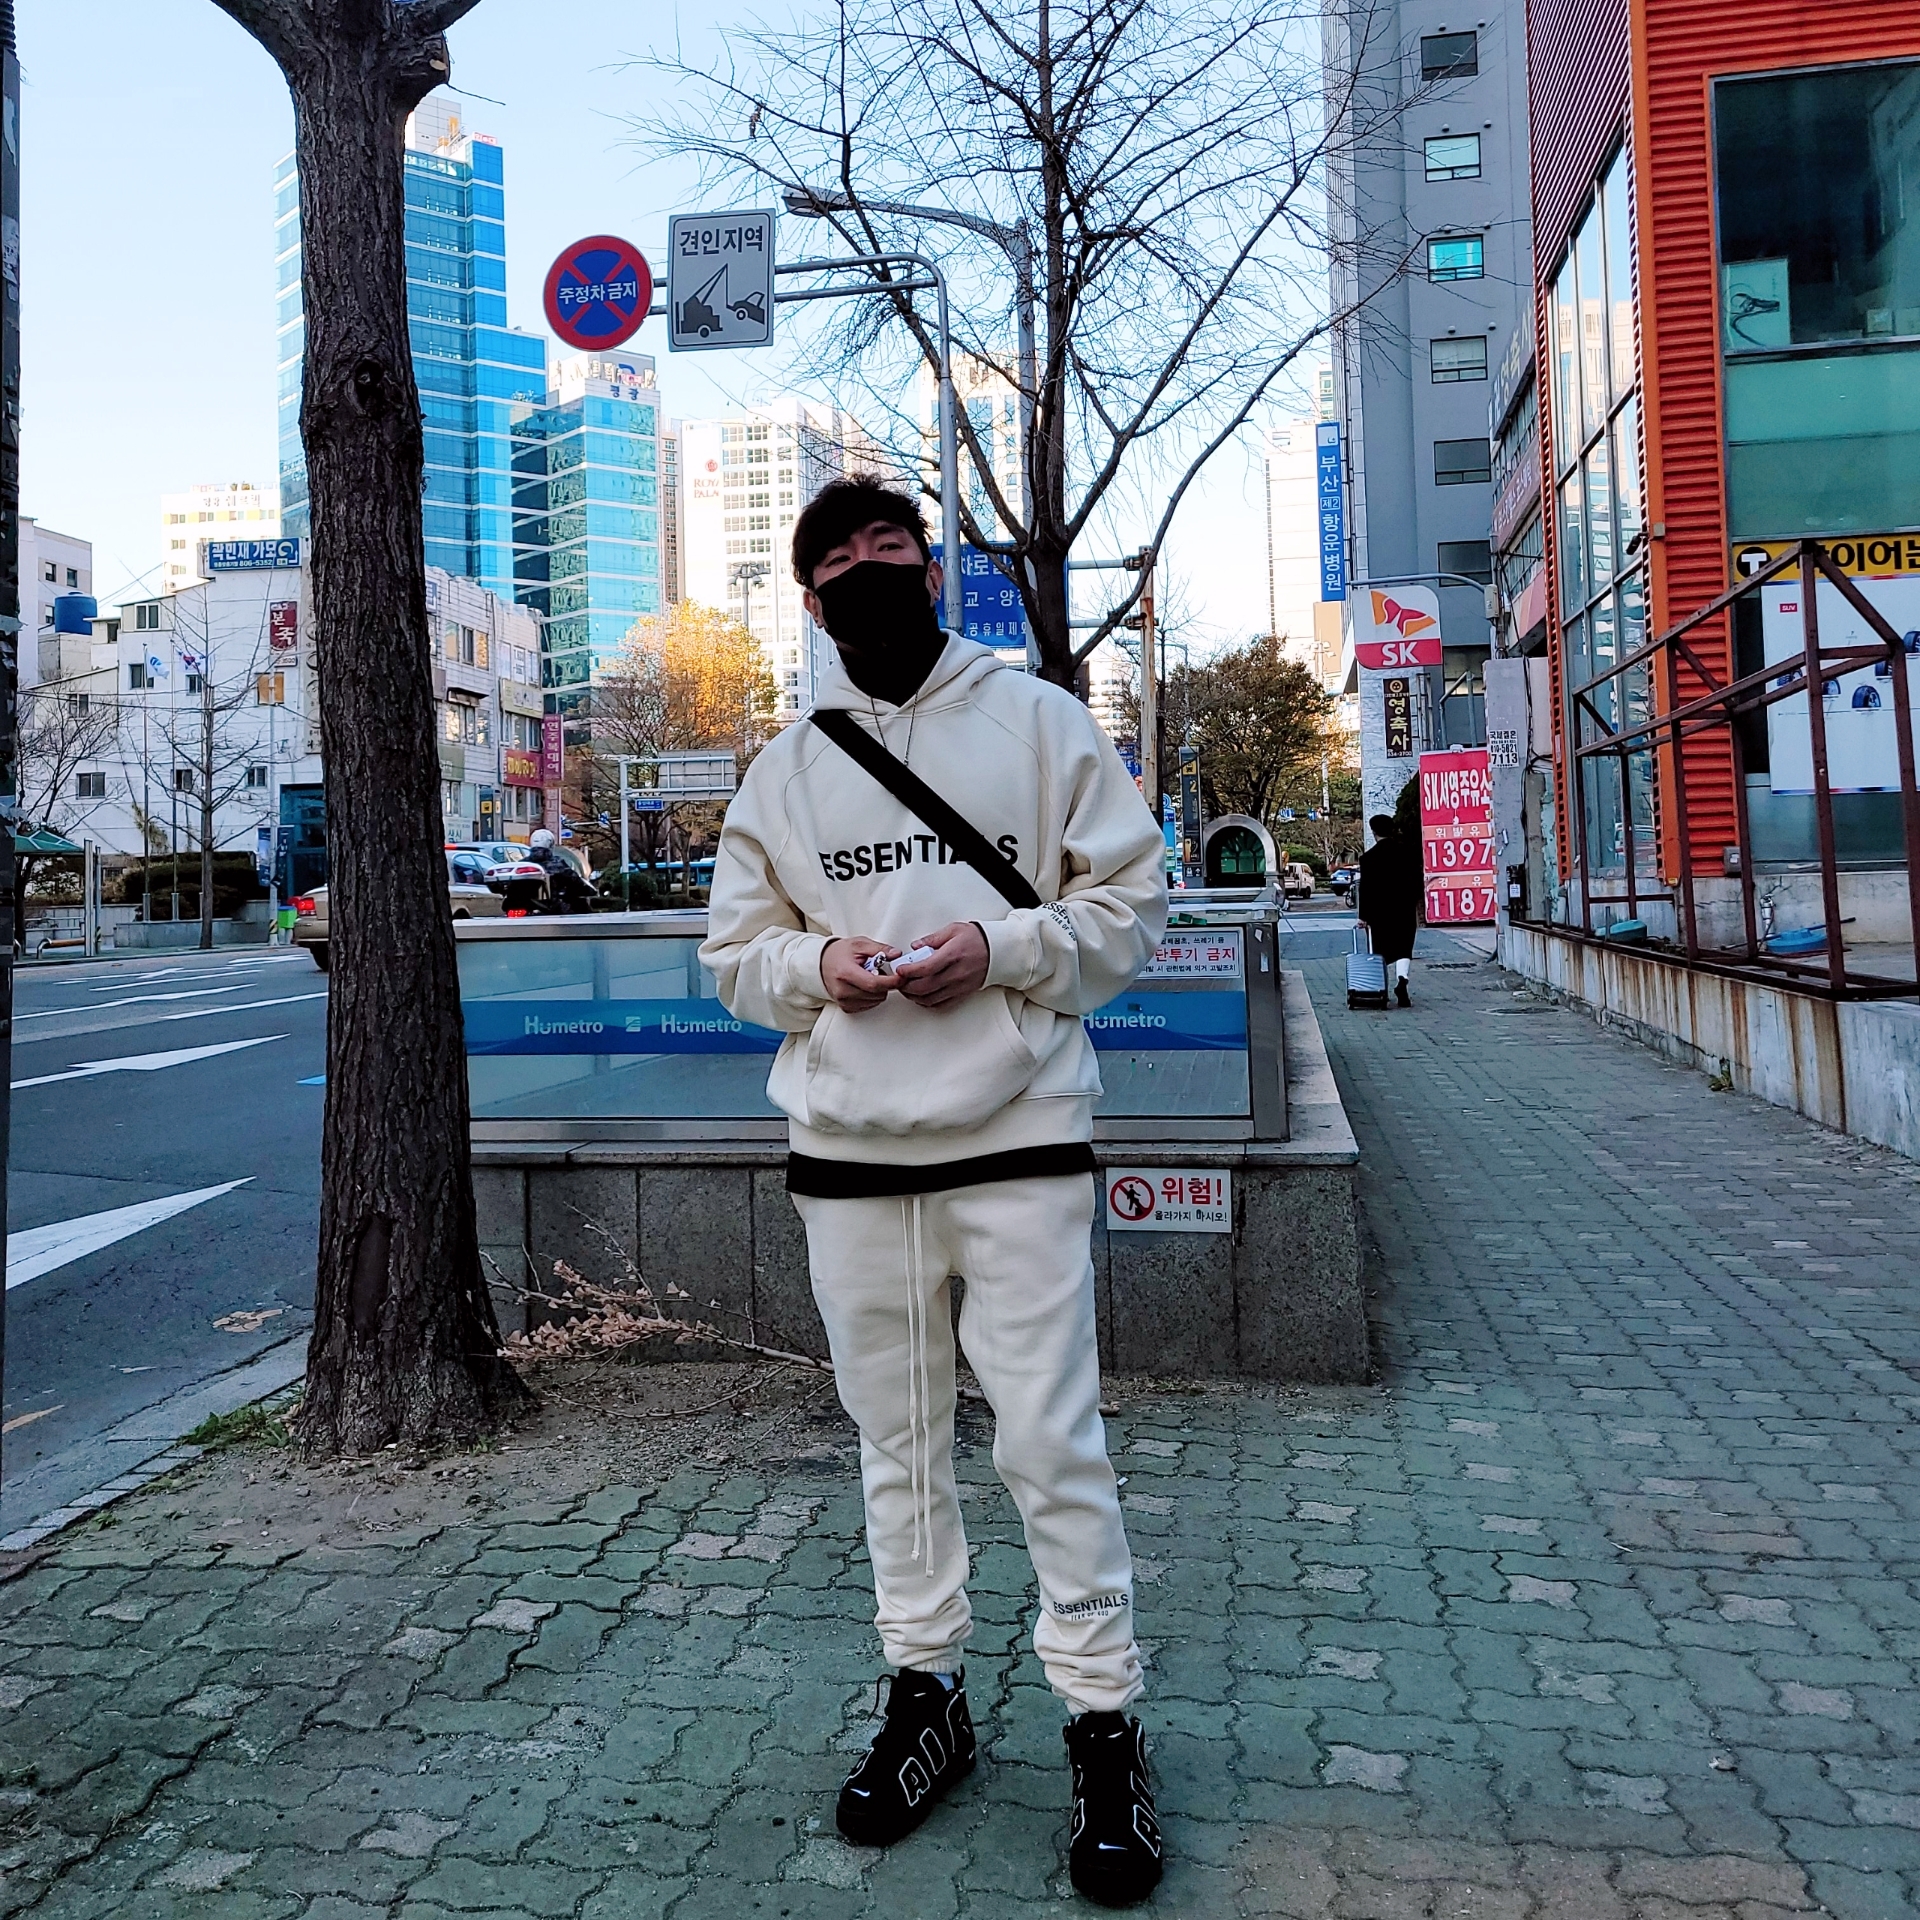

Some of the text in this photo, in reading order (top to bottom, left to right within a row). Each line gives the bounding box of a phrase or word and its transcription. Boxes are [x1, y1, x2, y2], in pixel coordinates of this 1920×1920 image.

[680, 226, 763, 256] 견인지역
[559, 281, 637, 304] 주정차 금지
[1320, 455, 1342, 592] 부산 제2 항운병원
[271, 611, 296, 646] 본죽
[1382, 641, 1420, 666] SK
[1388, 698, 1411, 751] 영축사
[1491, 753, 1518, 765] 7113
[818, 834, 1019, 882] ESSENTIS
[1428, 838, 1492, 868] 1397
[1430, 888, 1494, 917] 1187
[1193, 936, 1214, 945] 쓰레기
[1206, 946, 1236, 961] 금지
[1157, 964, 1164, 973] 시
[1161, 1177, 1223, 1206] 위험!
[1154, 1209, 1228, 1222] 올라가지 마시오!
[1053, 1594, 1129, 1615] ESSENTIALS
